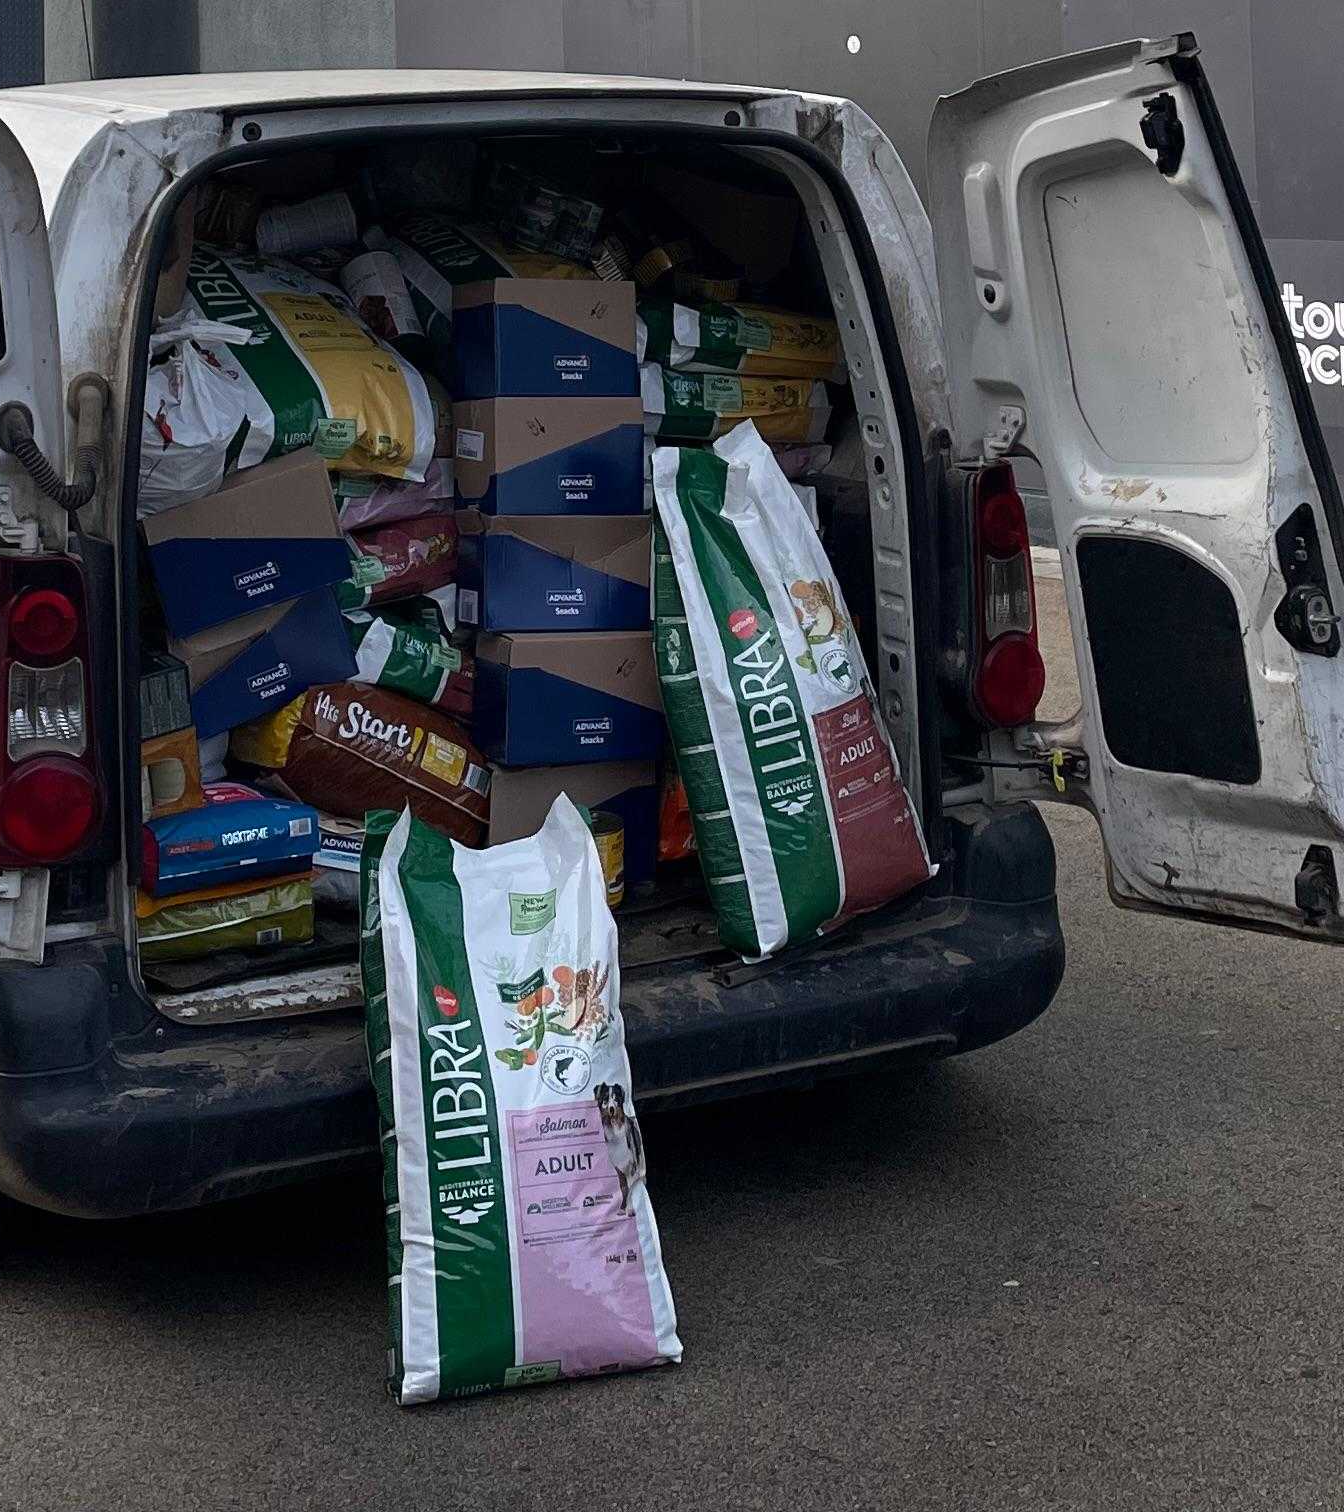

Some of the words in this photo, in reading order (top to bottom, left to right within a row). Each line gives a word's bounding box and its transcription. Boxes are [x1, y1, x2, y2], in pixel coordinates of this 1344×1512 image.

[556, 359, 588, 367] ADVANCE
[561, 372, 582, 380] Snacks
[560, 478, 593, 487] ADVANCE
[566, 491, 588, 500] Snacks
[238, 566, 277, 586] ADVANCE
[246, 582, 274, 597] Snacks
[548, 594, 584, 602] ADVANCE
[555, 607, 579, 615] Snacks
[251, 667, 288, 688] ADVANCE
[260, 684, 286, 700] Snacks
[733, 631, 807, 773] LIBRA
[575, 721, 610, 731] ADVANCE
[580, 736, 604, 745] Snacks
[839, 736, 875, 766] ADULT
[766, 778, 814, 800] BALANCE
[524, 896, 544, 905] NEW
[427, 1019, 492, 1171] LIBRA
[535, 1152, 594, 1176] ADULT
[439, 1178, 494, 1191] MEDITERRANEAN
[439, 1185, 495, 1203] BALANCE
